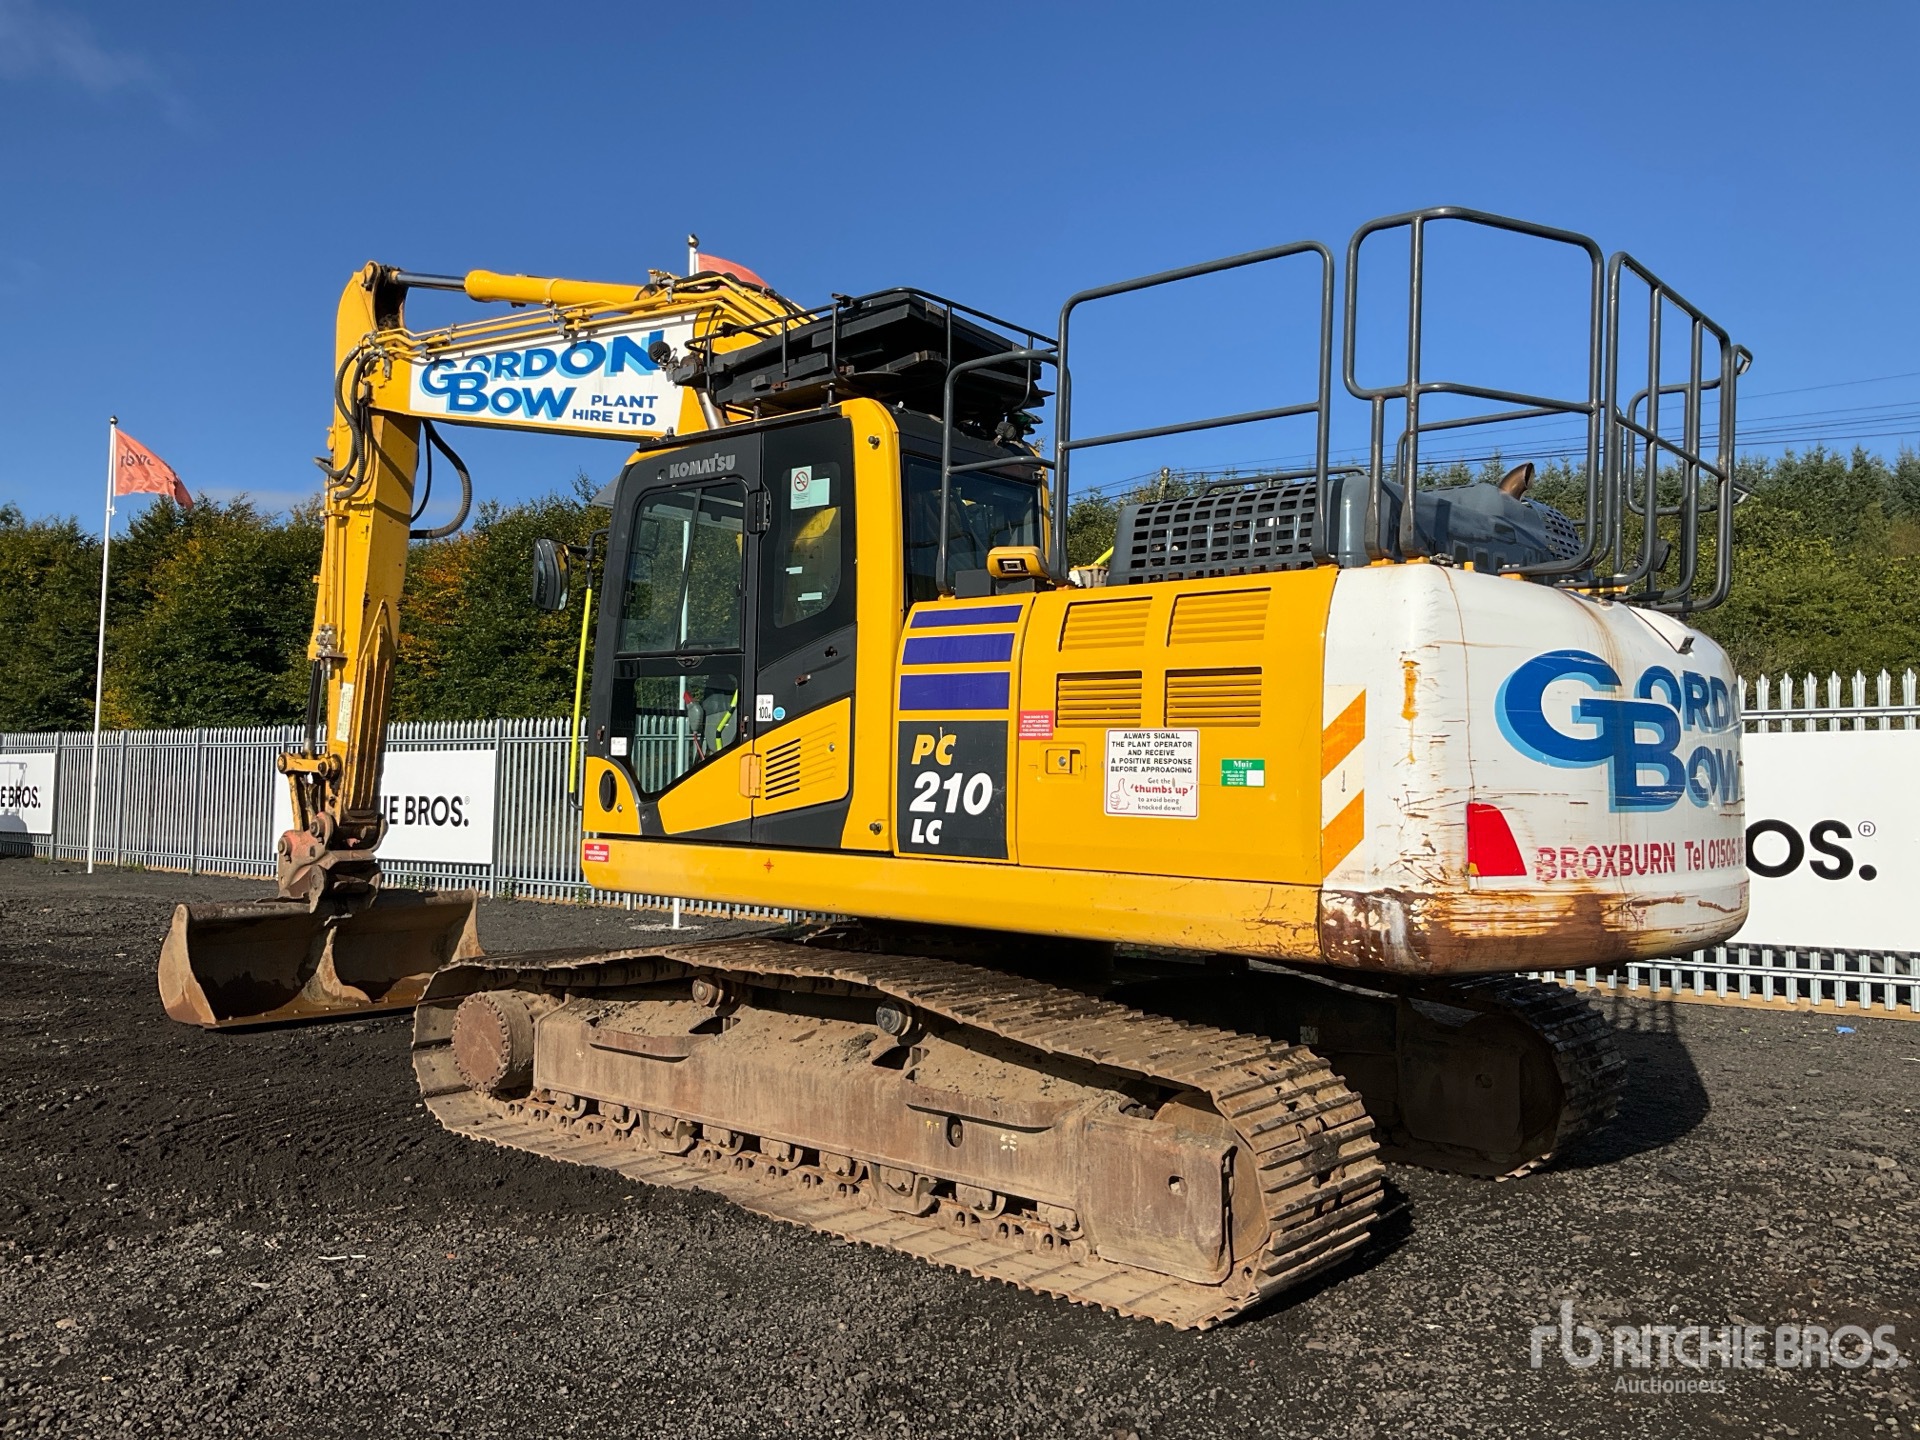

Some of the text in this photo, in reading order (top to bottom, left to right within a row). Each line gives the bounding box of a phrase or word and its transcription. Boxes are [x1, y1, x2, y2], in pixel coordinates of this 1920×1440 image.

[420, 330, 664, 398] GORDON
[446, 371, 578, 420] BOW
[592, 395, 658, 409] PLANT
[572, 410, 656, 426] HIRE LTD
[669, 452, 736, 479] KOMATSU
[911, 734, 957, 766] PC
[9, 785, 41, 809] BROS.
[909, 771, 993, 816] 210
[1163, 797, 1180, 805] being
[404, 796, 469, 827] BROS.
[911, 818, 943, 845] LC
[1535, 842, 1676, 881] BROXBURN
[1684, 840, 1705, 870] Tel
[1708, 838, 1736, 869] 01506
